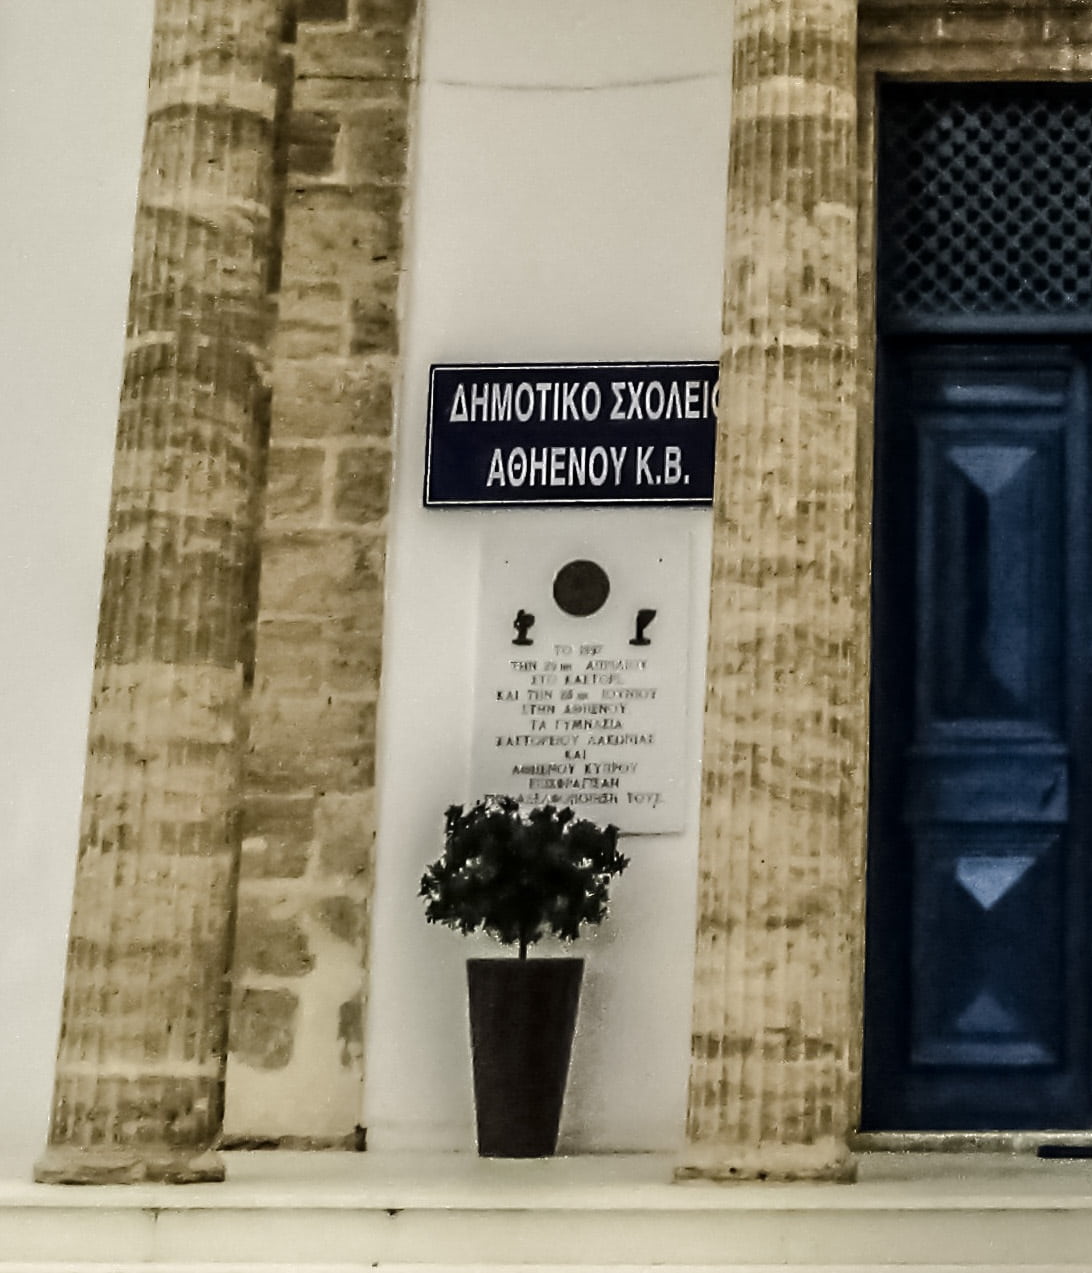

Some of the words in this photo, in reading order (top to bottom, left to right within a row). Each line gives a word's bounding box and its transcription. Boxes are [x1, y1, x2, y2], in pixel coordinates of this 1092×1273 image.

[449, 381, 602, 423] ΔΗΜΟΤΙΚΟ
[486, 446, 627, 487] ΑΘΗΕΝΟΥ
[636, 445, 691, 485] Κ.Β.
[531, 719, 546, 730] ΤΑ
[565, 749, 586, 760] ΚΑΙ
